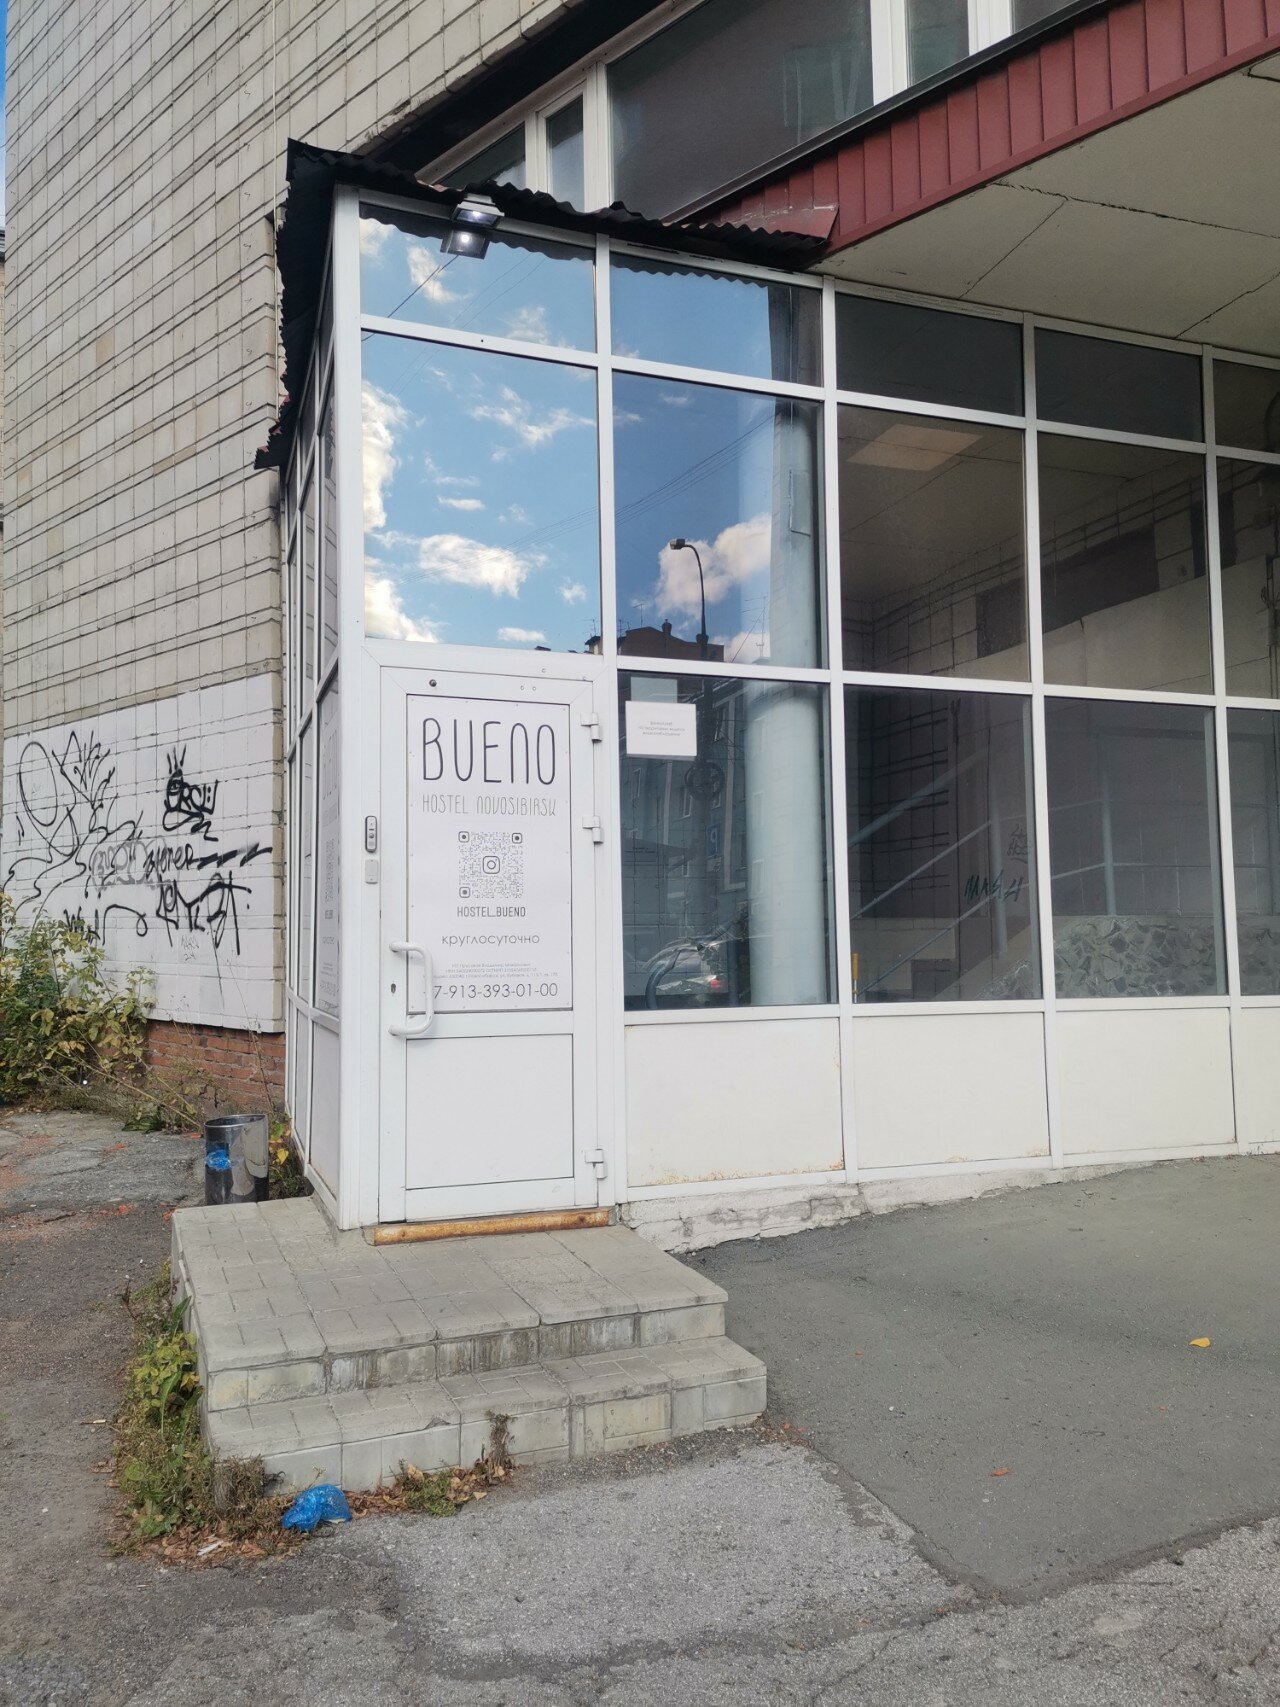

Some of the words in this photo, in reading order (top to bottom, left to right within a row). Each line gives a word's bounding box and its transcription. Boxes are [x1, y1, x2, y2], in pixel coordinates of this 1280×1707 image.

[422, 717, 556, 785] BUENO
[422, 794, 468, 815] HOSTEL
[441, 934, 540, 947] круглосуточно
